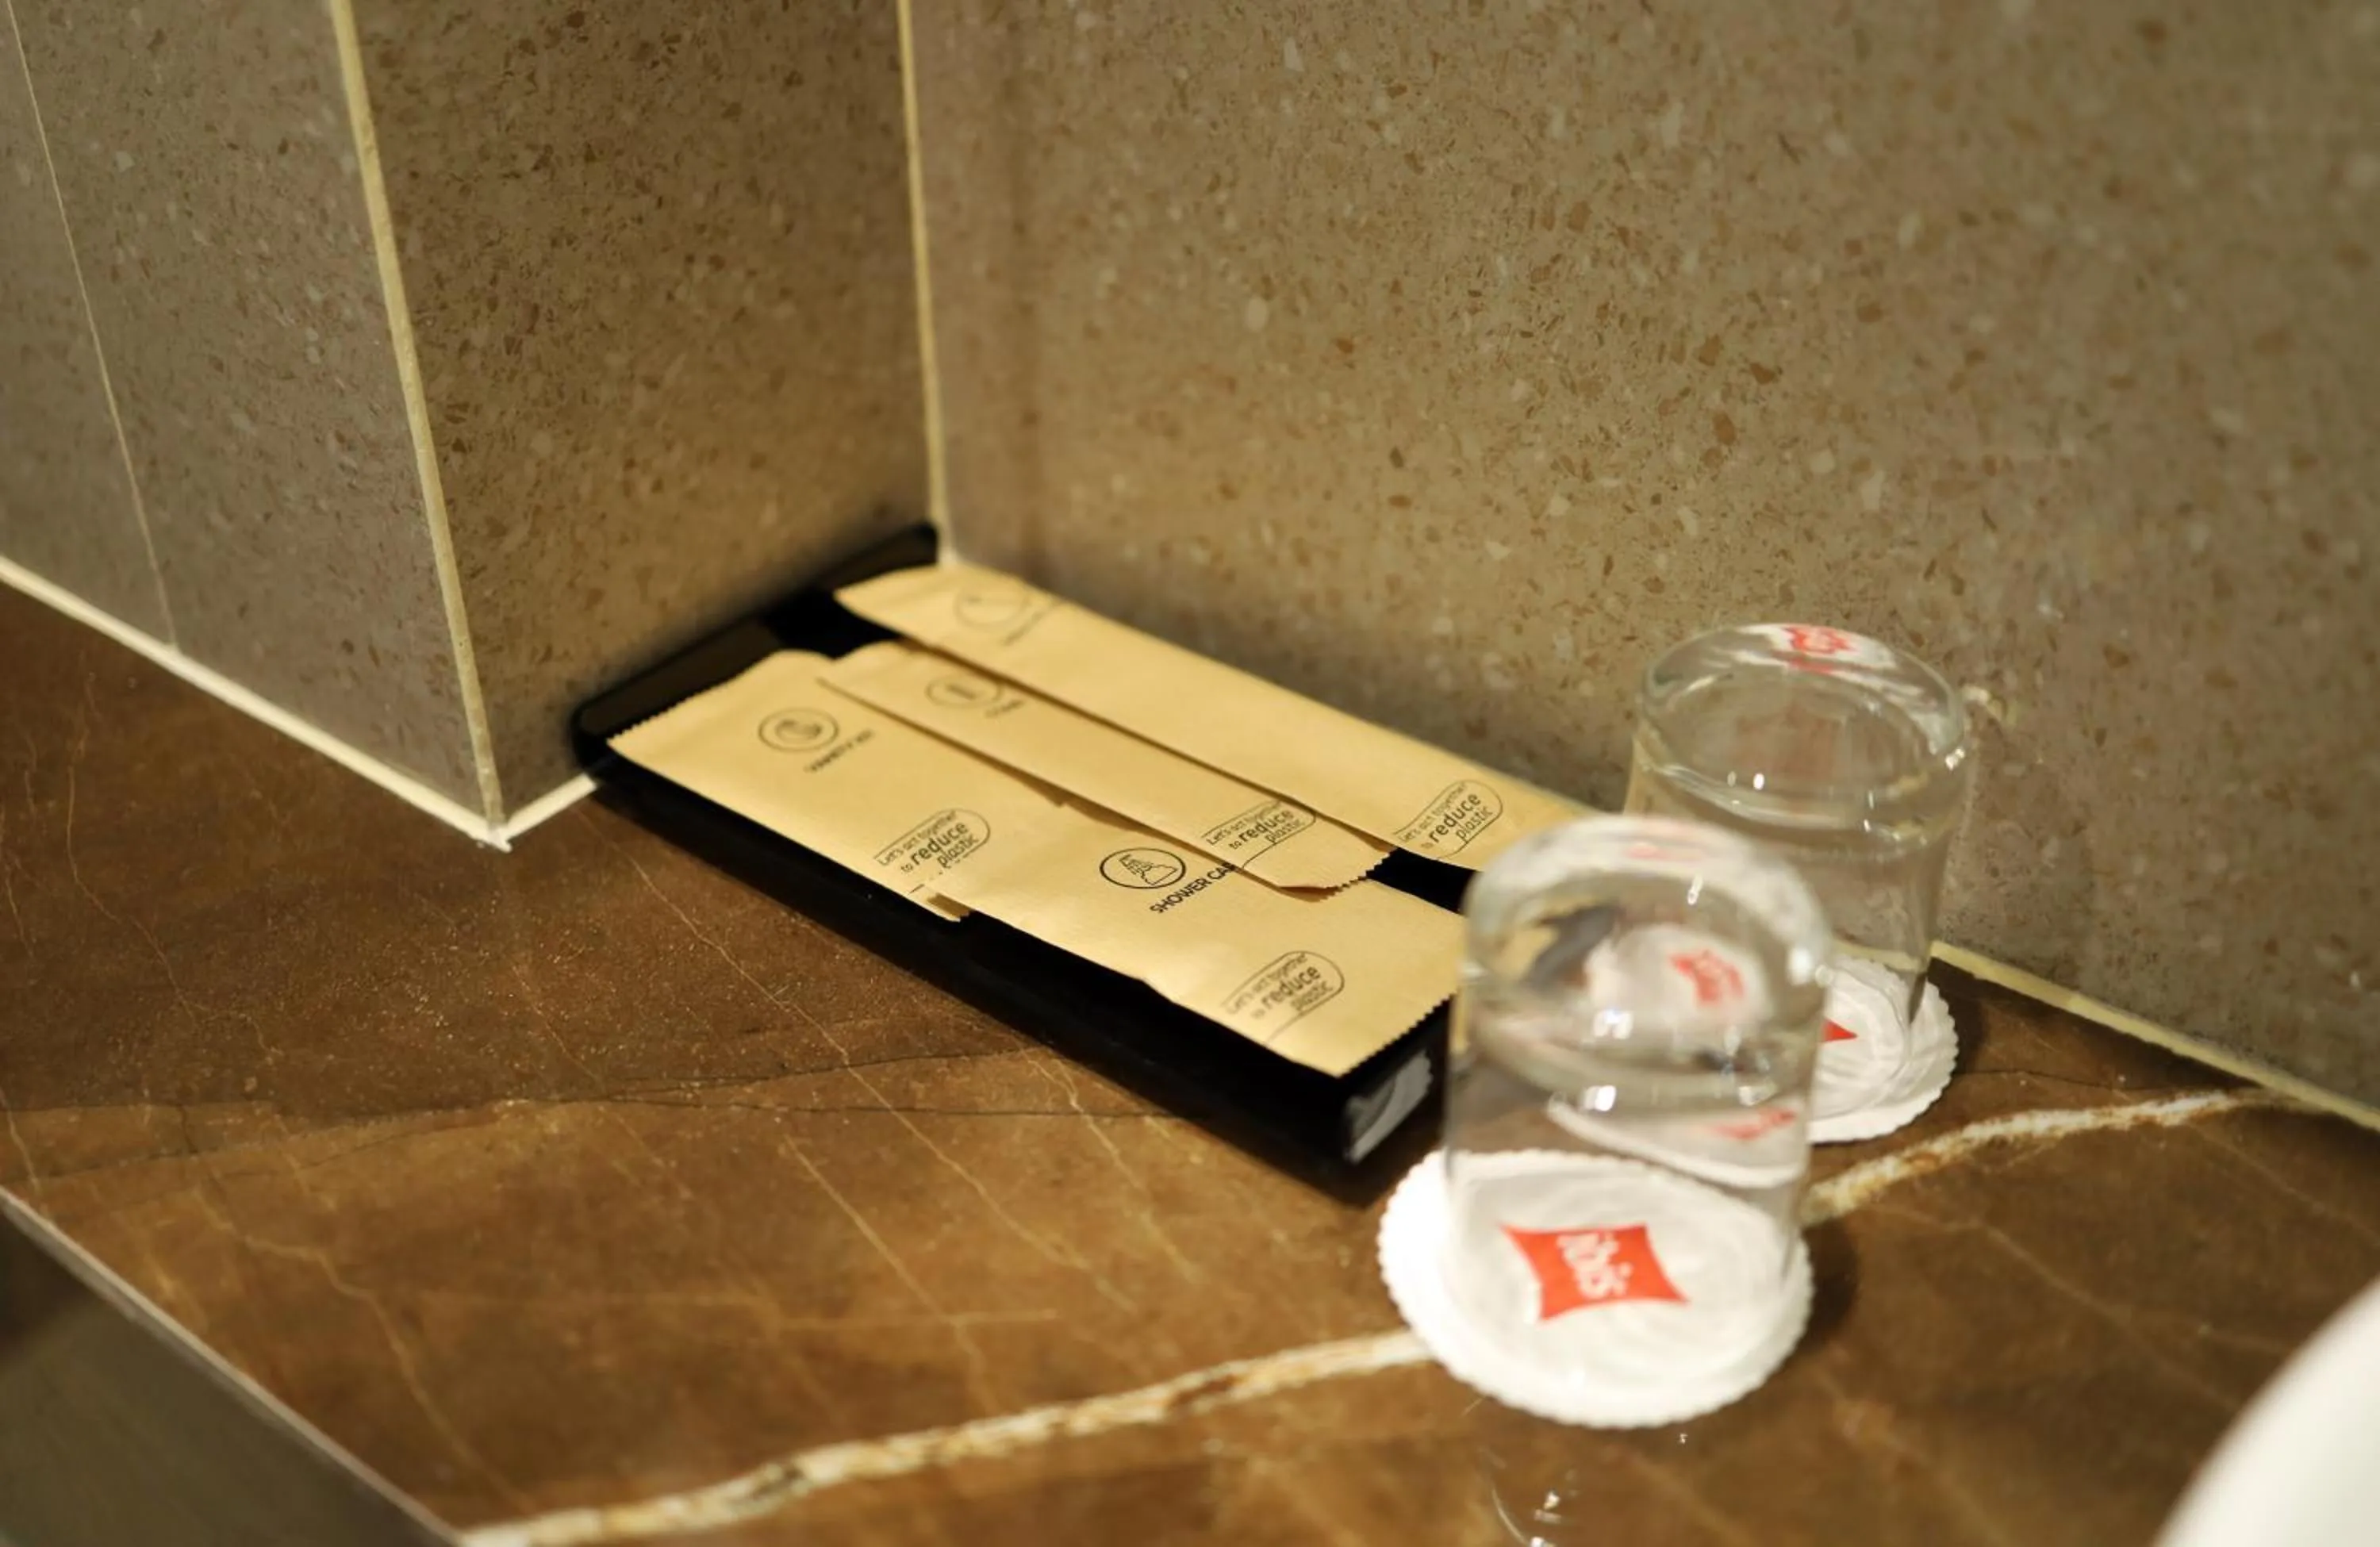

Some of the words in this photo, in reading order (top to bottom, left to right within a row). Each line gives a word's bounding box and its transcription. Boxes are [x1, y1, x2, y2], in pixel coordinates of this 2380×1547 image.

[1206, 827, 1231, 846] Let's
[1229, 840, 1242, 850] to
[1239, 809, 1295, 843] reduce
[1429, 793, 1481, 843] reduce
[1456, 805, 1492, 843] plastic
[877, 848, 904, 866] Let's
[900, 863, 913, 873] to
[910, 822, 969, 866] reduce
[936, 834, 979, 869] plastic
[1150, 877, 1212, 913] SHOWER
[1261, 966, 1321, 1009] reduce
